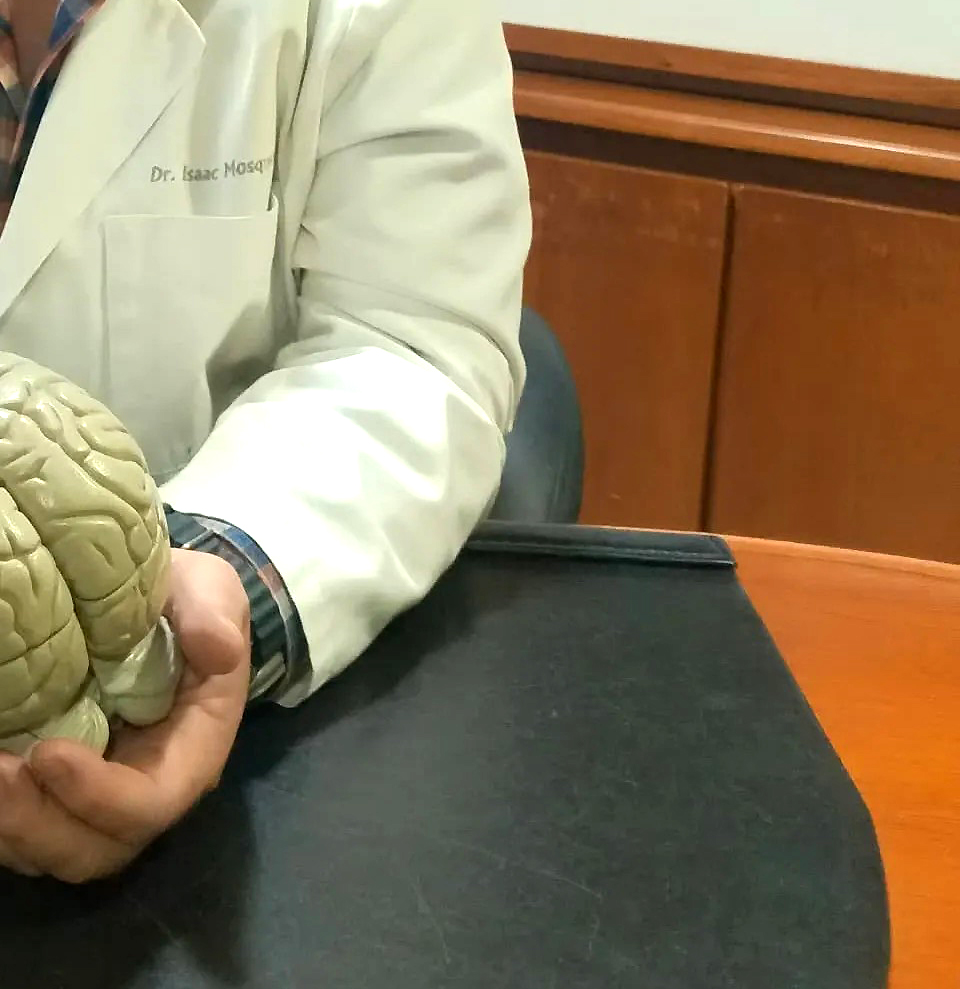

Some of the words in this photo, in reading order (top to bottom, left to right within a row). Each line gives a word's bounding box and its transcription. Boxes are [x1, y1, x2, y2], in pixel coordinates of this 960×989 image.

[150, 165, 176, 183] Dr.
[182, 165, 219, 182] Isaac
[223, 157, 273, 179] Mosq
